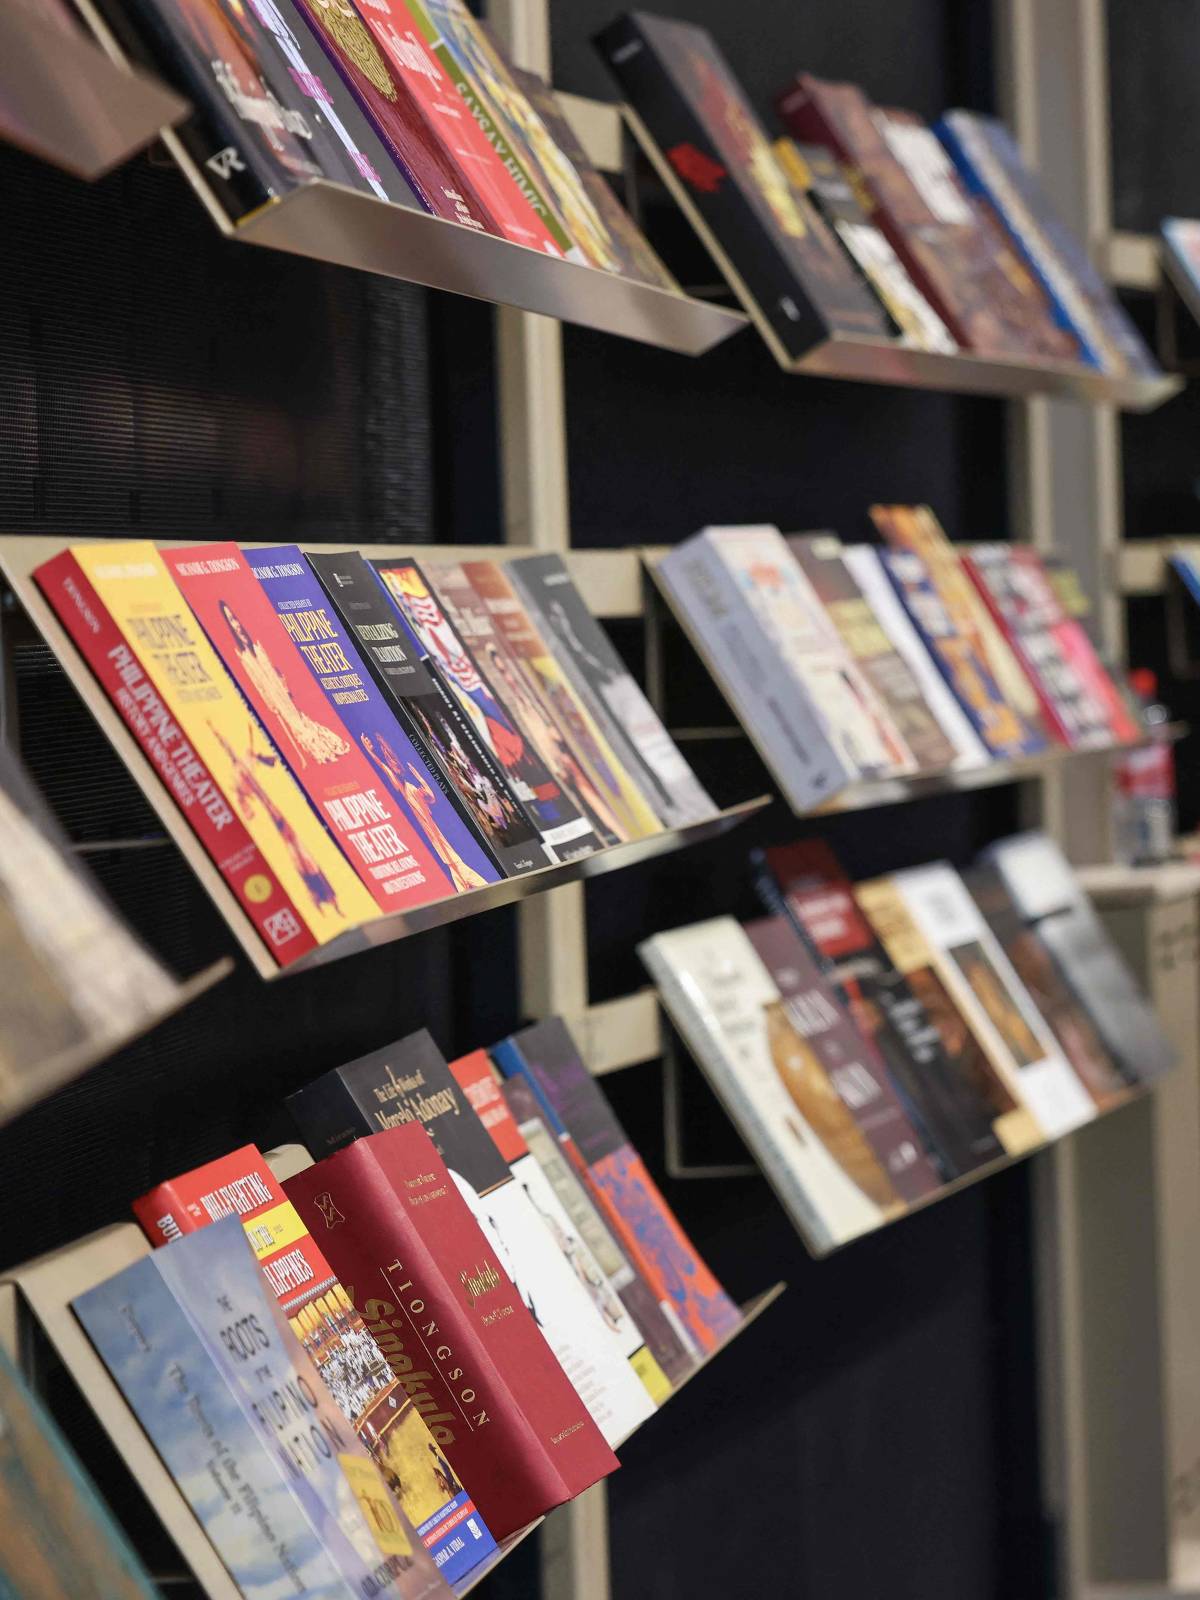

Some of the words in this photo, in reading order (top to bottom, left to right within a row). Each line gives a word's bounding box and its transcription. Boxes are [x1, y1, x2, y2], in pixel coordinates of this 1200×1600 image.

[456, 82, 507, 154] SAYSAY
[277, 609, 339, 642] PHILIPPINE
[300, 642, 354, 674] THEATER
[107, 643, 181, 746] PHILIPPINE
[172, 741, 233, 832] THEATER
[323, 789, 392, 832] PHILIPPINE
[347, 823, 410, 865] THEATER
[408, 1087, 460, 1124] Adonay
[220, 1313, 271, 1362] ROOTS
[387, 1259, 491, 1427] TIONGSON
